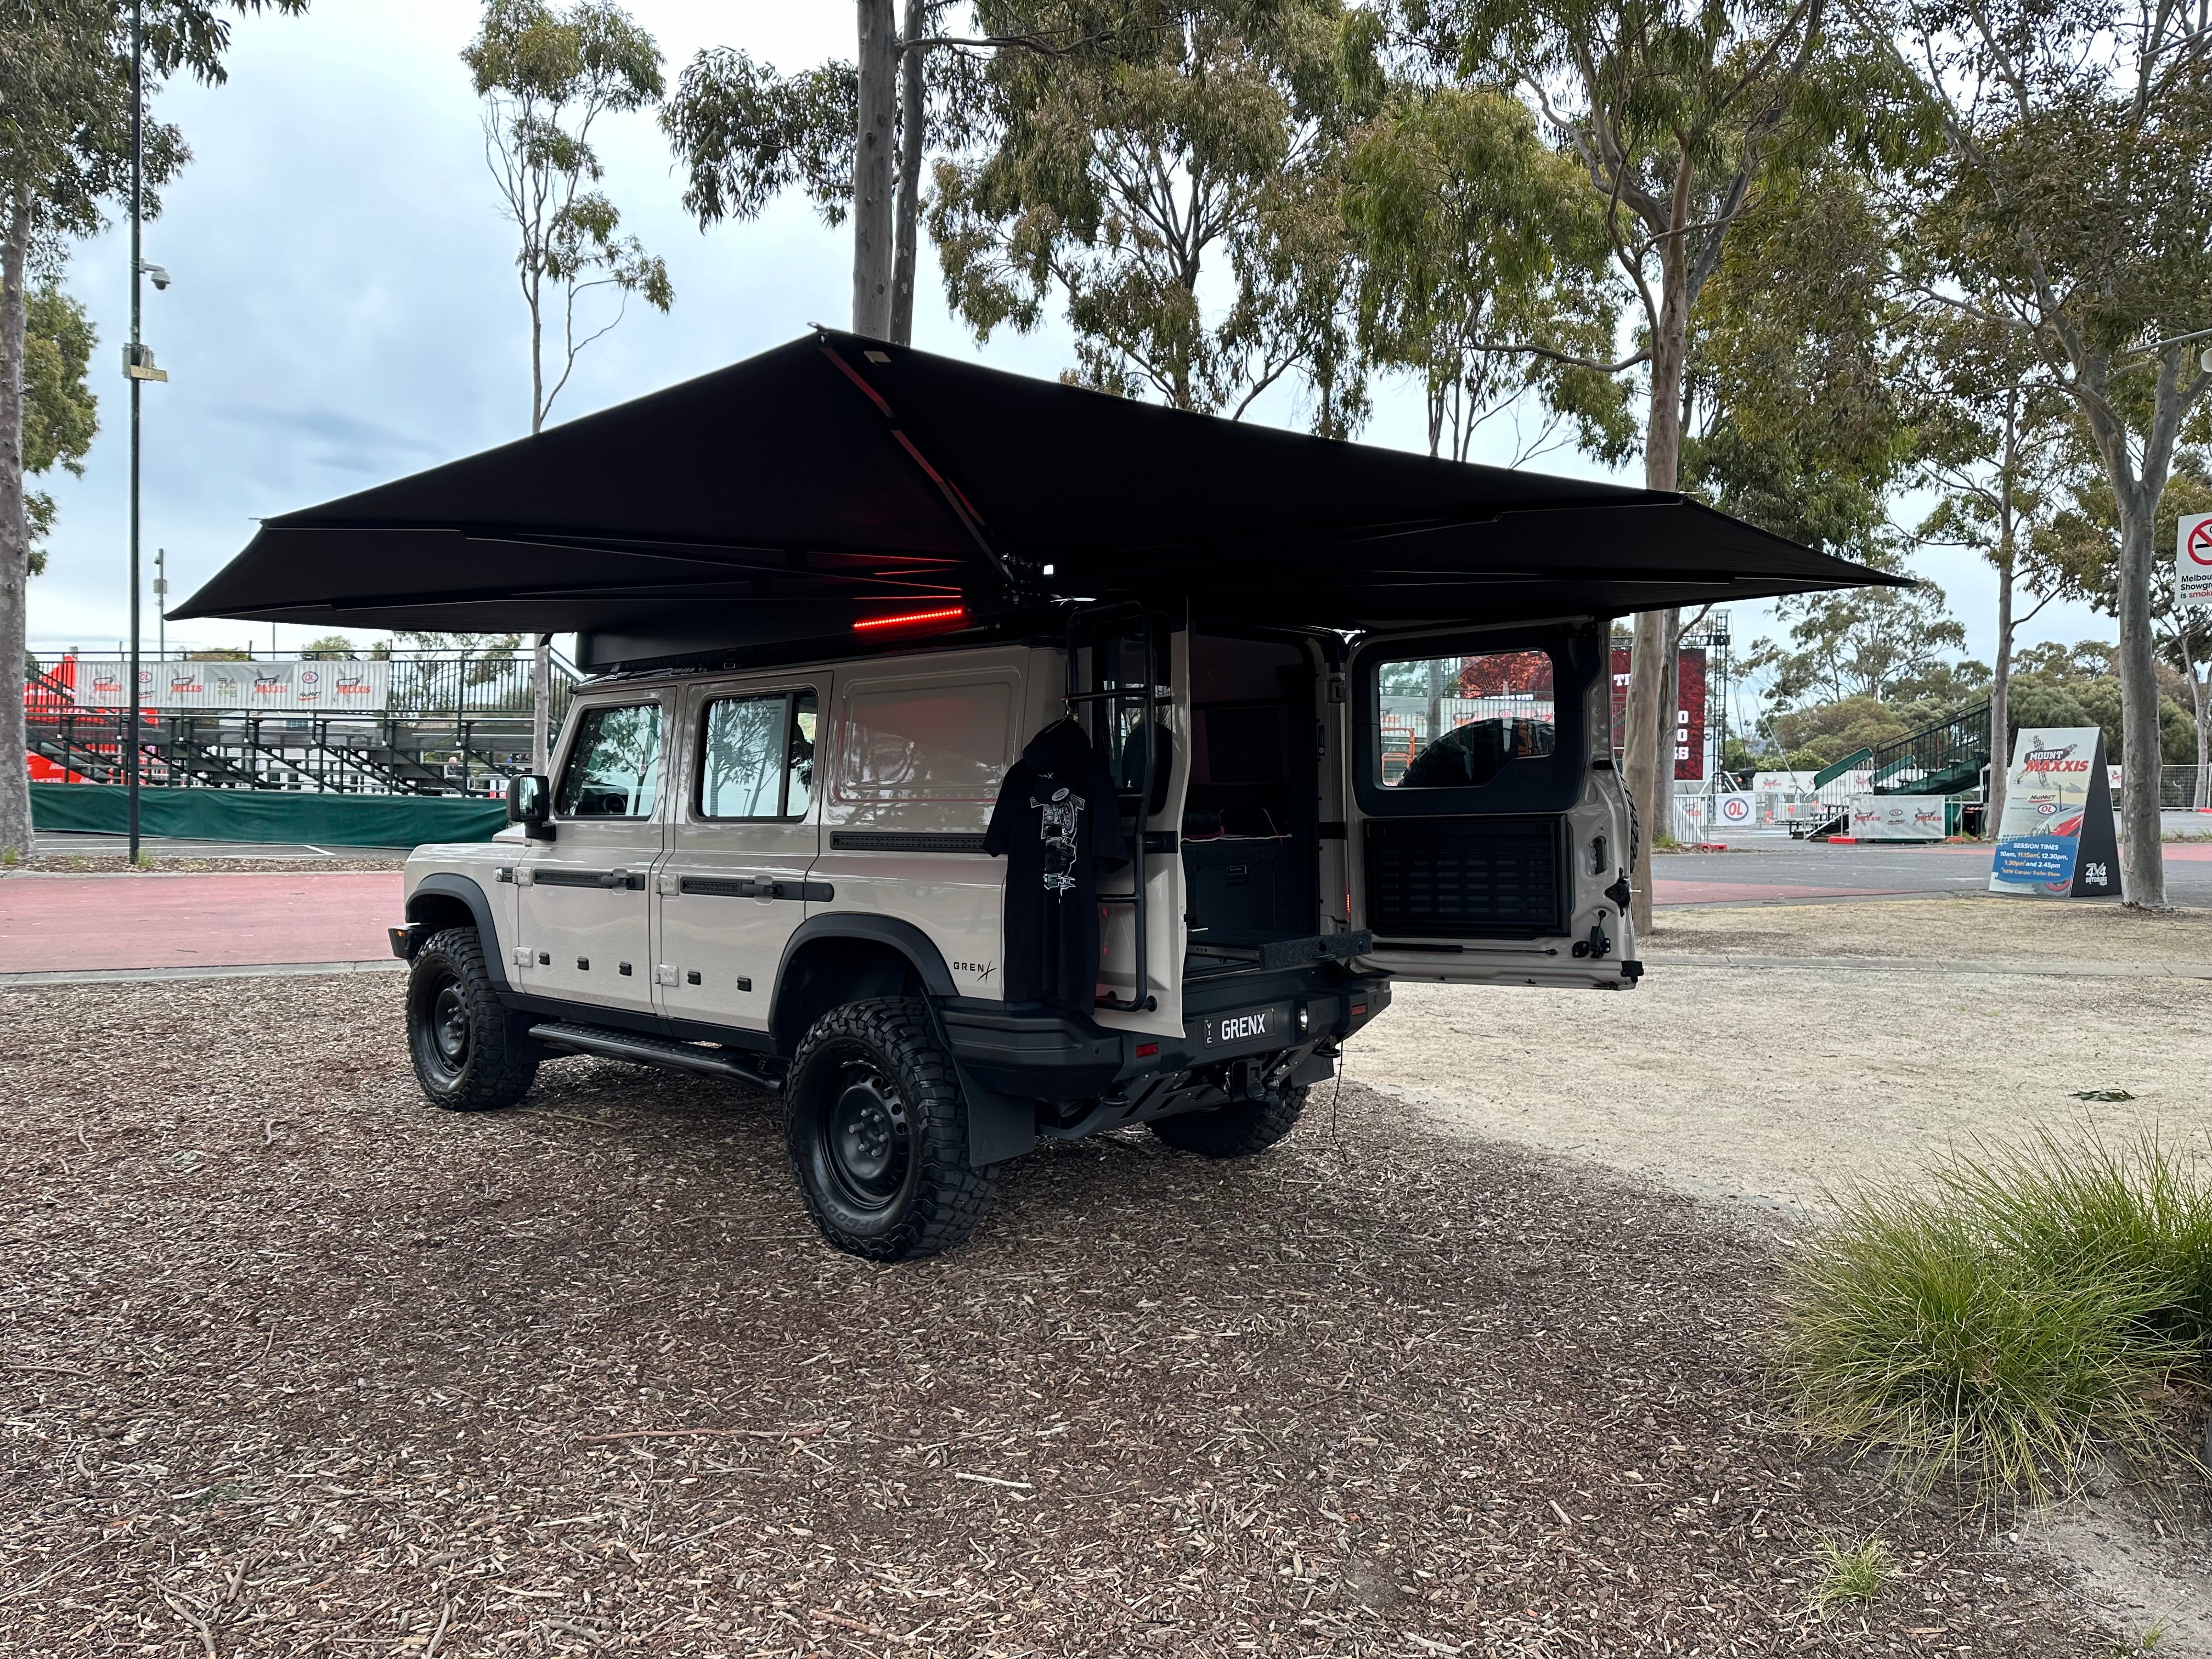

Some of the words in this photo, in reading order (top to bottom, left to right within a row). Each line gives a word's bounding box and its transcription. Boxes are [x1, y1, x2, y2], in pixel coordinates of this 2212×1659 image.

[2181, 583, 2212, 591] Showgr
[2188, 590, 2212, 598] smok
[337, 685, 371, 693] MAXXIS
[2030, 751, 2063, 760] MOUNT
[2024, 760, 2089, 772] MAXXIS
[1729, 802, 1743, 816] OL
[1221, 1013, 1266, 1040] GRENX
